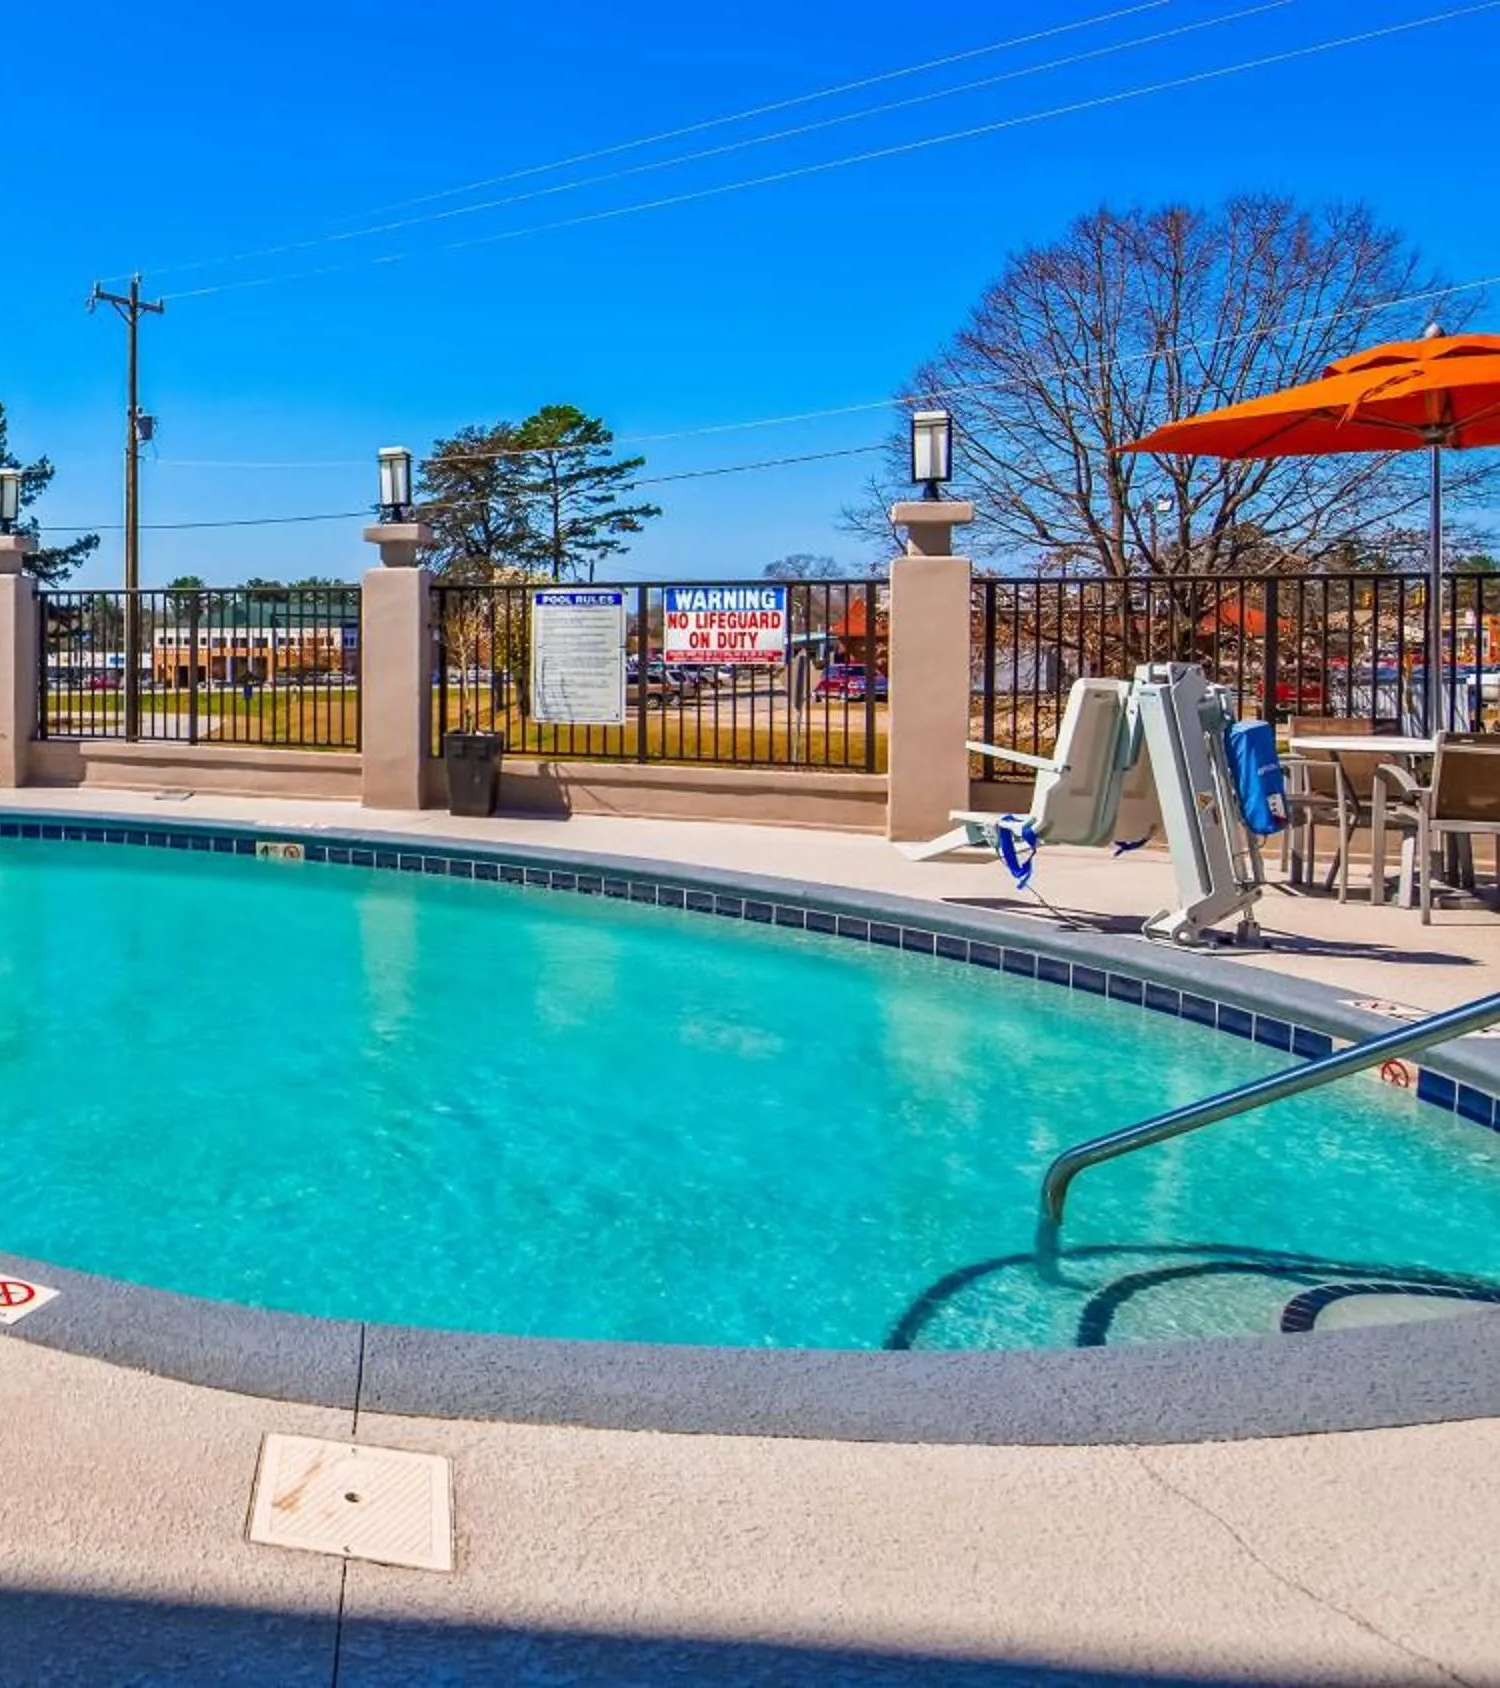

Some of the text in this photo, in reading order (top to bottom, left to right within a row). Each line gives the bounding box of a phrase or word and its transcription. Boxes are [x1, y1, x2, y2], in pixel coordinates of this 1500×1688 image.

[542, 595, 614, 605] POOL RULES
[674, 589, 777, 610] WARNING
[667, 612, 781, 629] NO LIFEGUARD
[689, 631, 759, 649] ON DUTY
